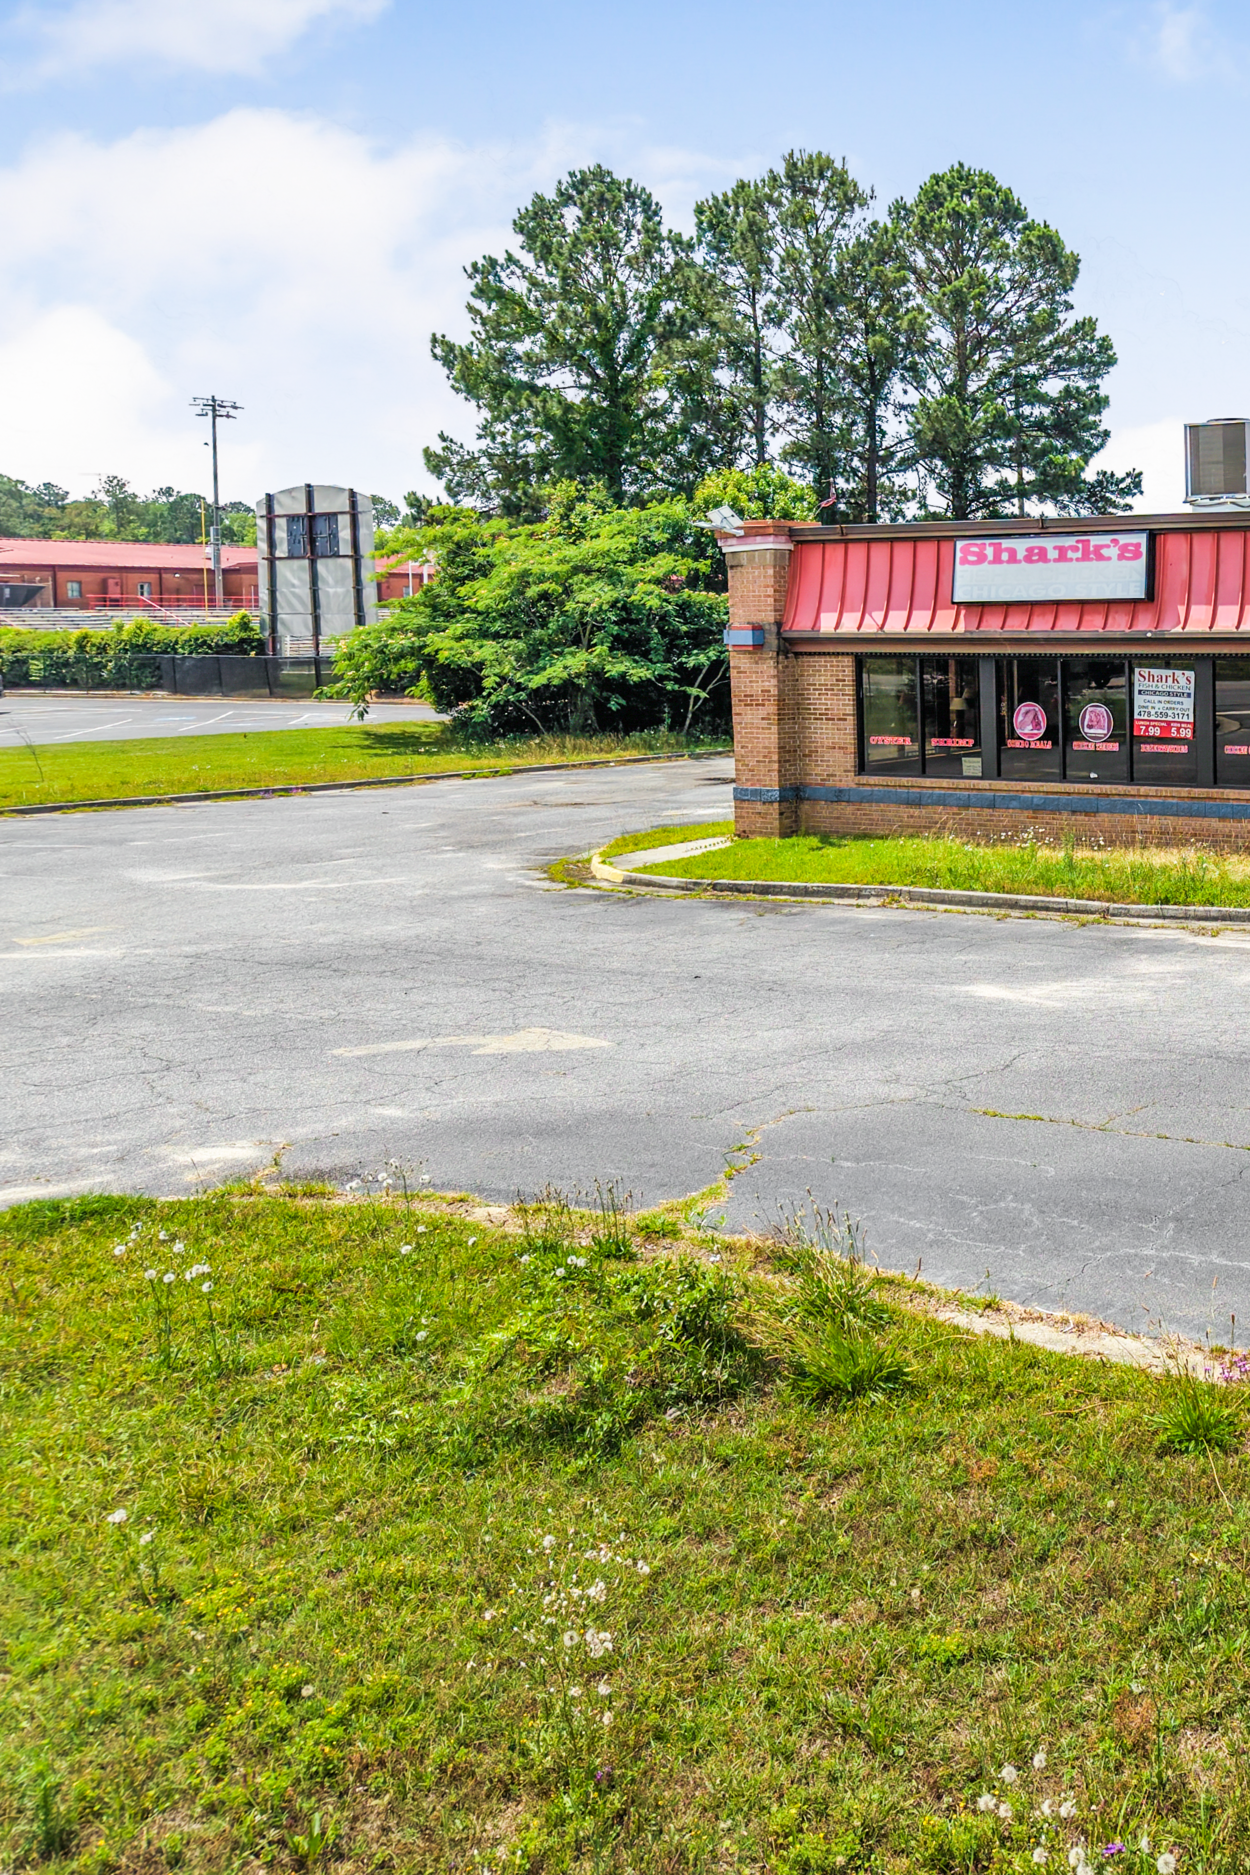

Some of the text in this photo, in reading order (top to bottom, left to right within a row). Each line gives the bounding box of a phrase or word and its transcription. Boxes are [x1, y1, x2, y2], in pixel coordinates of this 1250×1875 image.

[959, 538, 1143, 566] Shark's
[958, 582, 1141, 599] CHICAGO STYLE
[1138, 670, 1192, 685] Shark's
[1137, 711, 1190, 720] 478-559-3171
[1140, 726, 1191, 738] 7.99 5.99
[870, 736, 912, 745] OYSTER
[931, 738, 974, 747] SHRIMP
